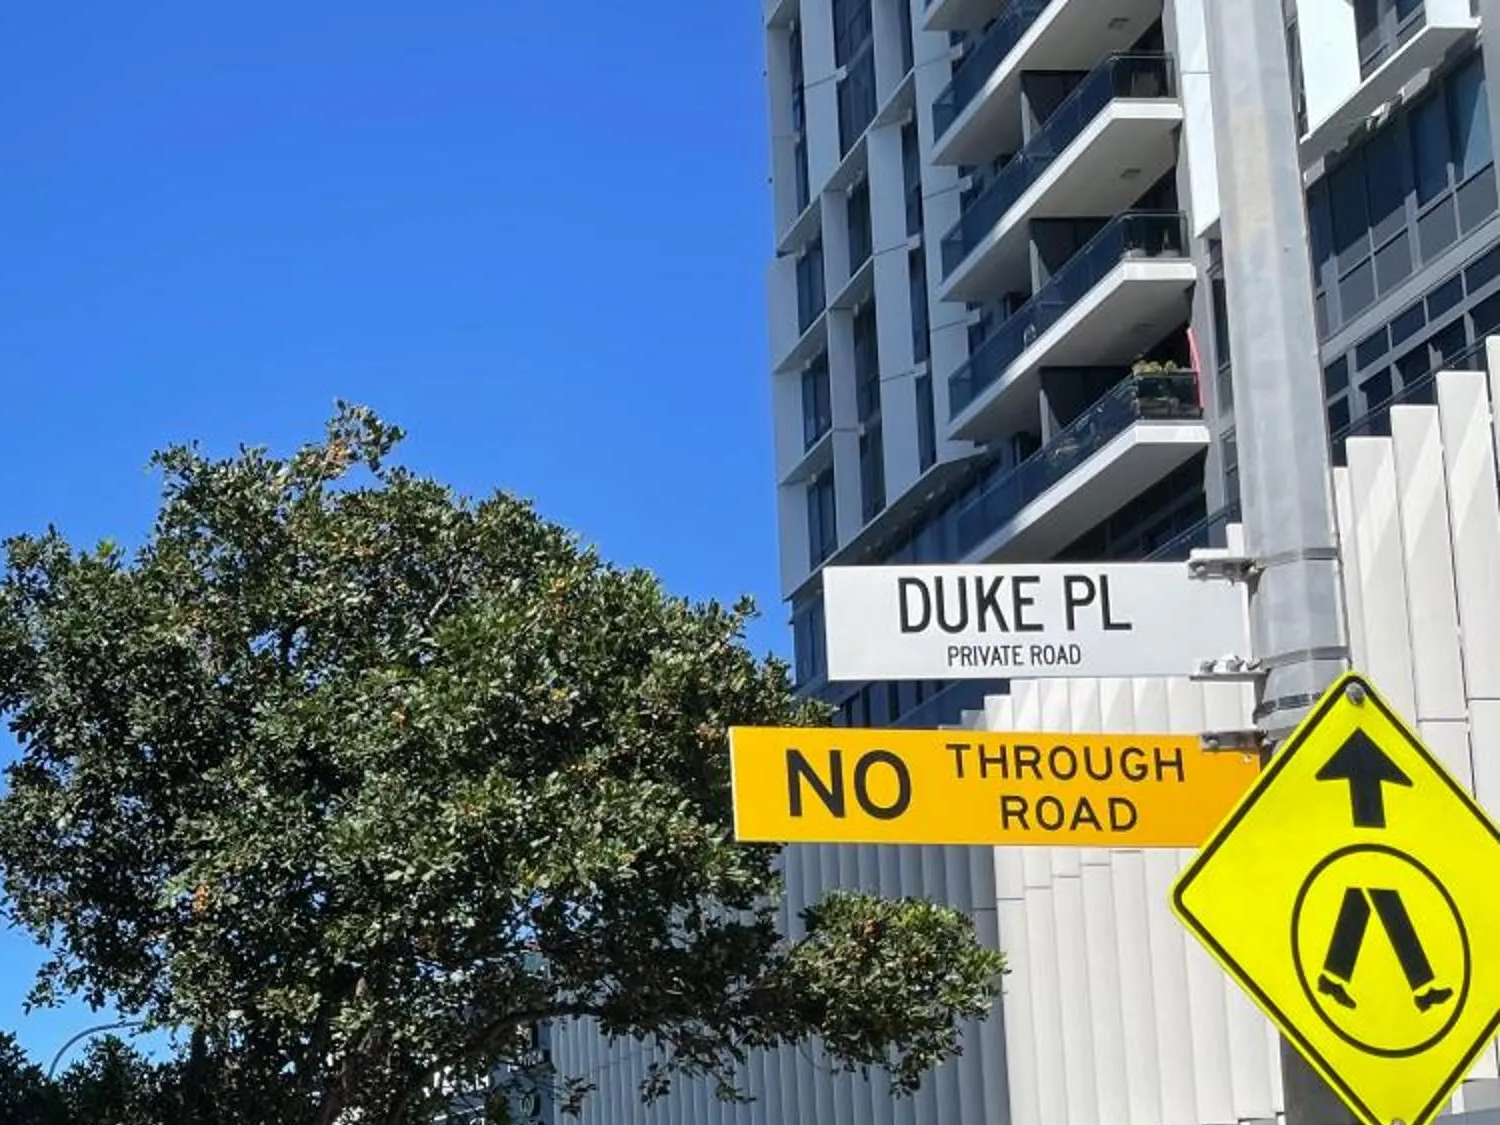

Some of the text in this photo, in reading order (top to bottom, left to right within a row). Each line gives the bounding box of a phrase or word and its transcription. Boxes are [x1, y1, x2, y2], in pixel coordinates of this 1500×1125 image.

[898, 575, 1133, 634] DUKE PL
[947, 644, 1082, 667] PRIVATE ROAD
[946, 743, 1186, 783] THROUGH
[785, 748, 912, 820] NO
[1001, 796, 1138, 832] ROAD
